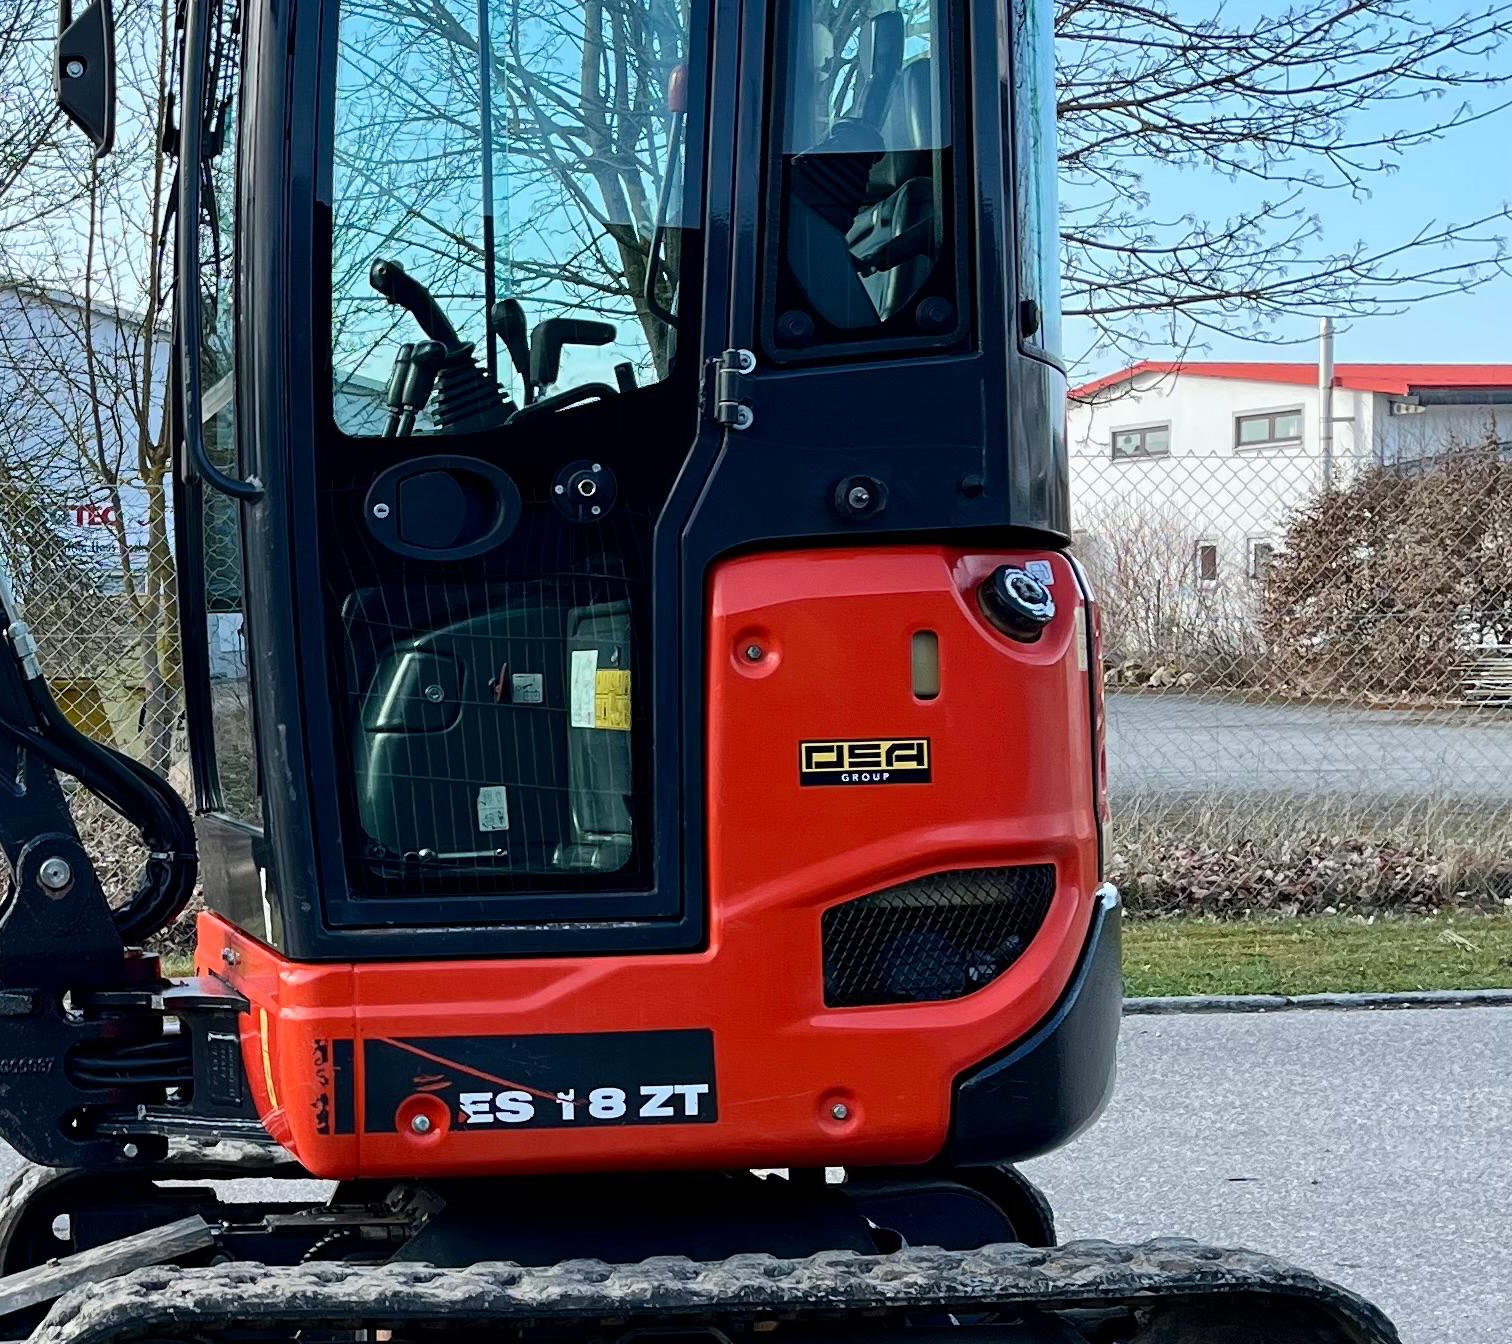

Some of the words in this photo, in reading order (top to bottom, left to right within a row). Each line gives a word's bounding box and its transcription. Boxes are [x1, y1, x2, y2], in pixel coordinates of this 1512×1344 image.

[840, 772, 890, 782] GROUP
[459, 1090, 535, 1124] ES
[639, 1083, 709, 1117] ZT
